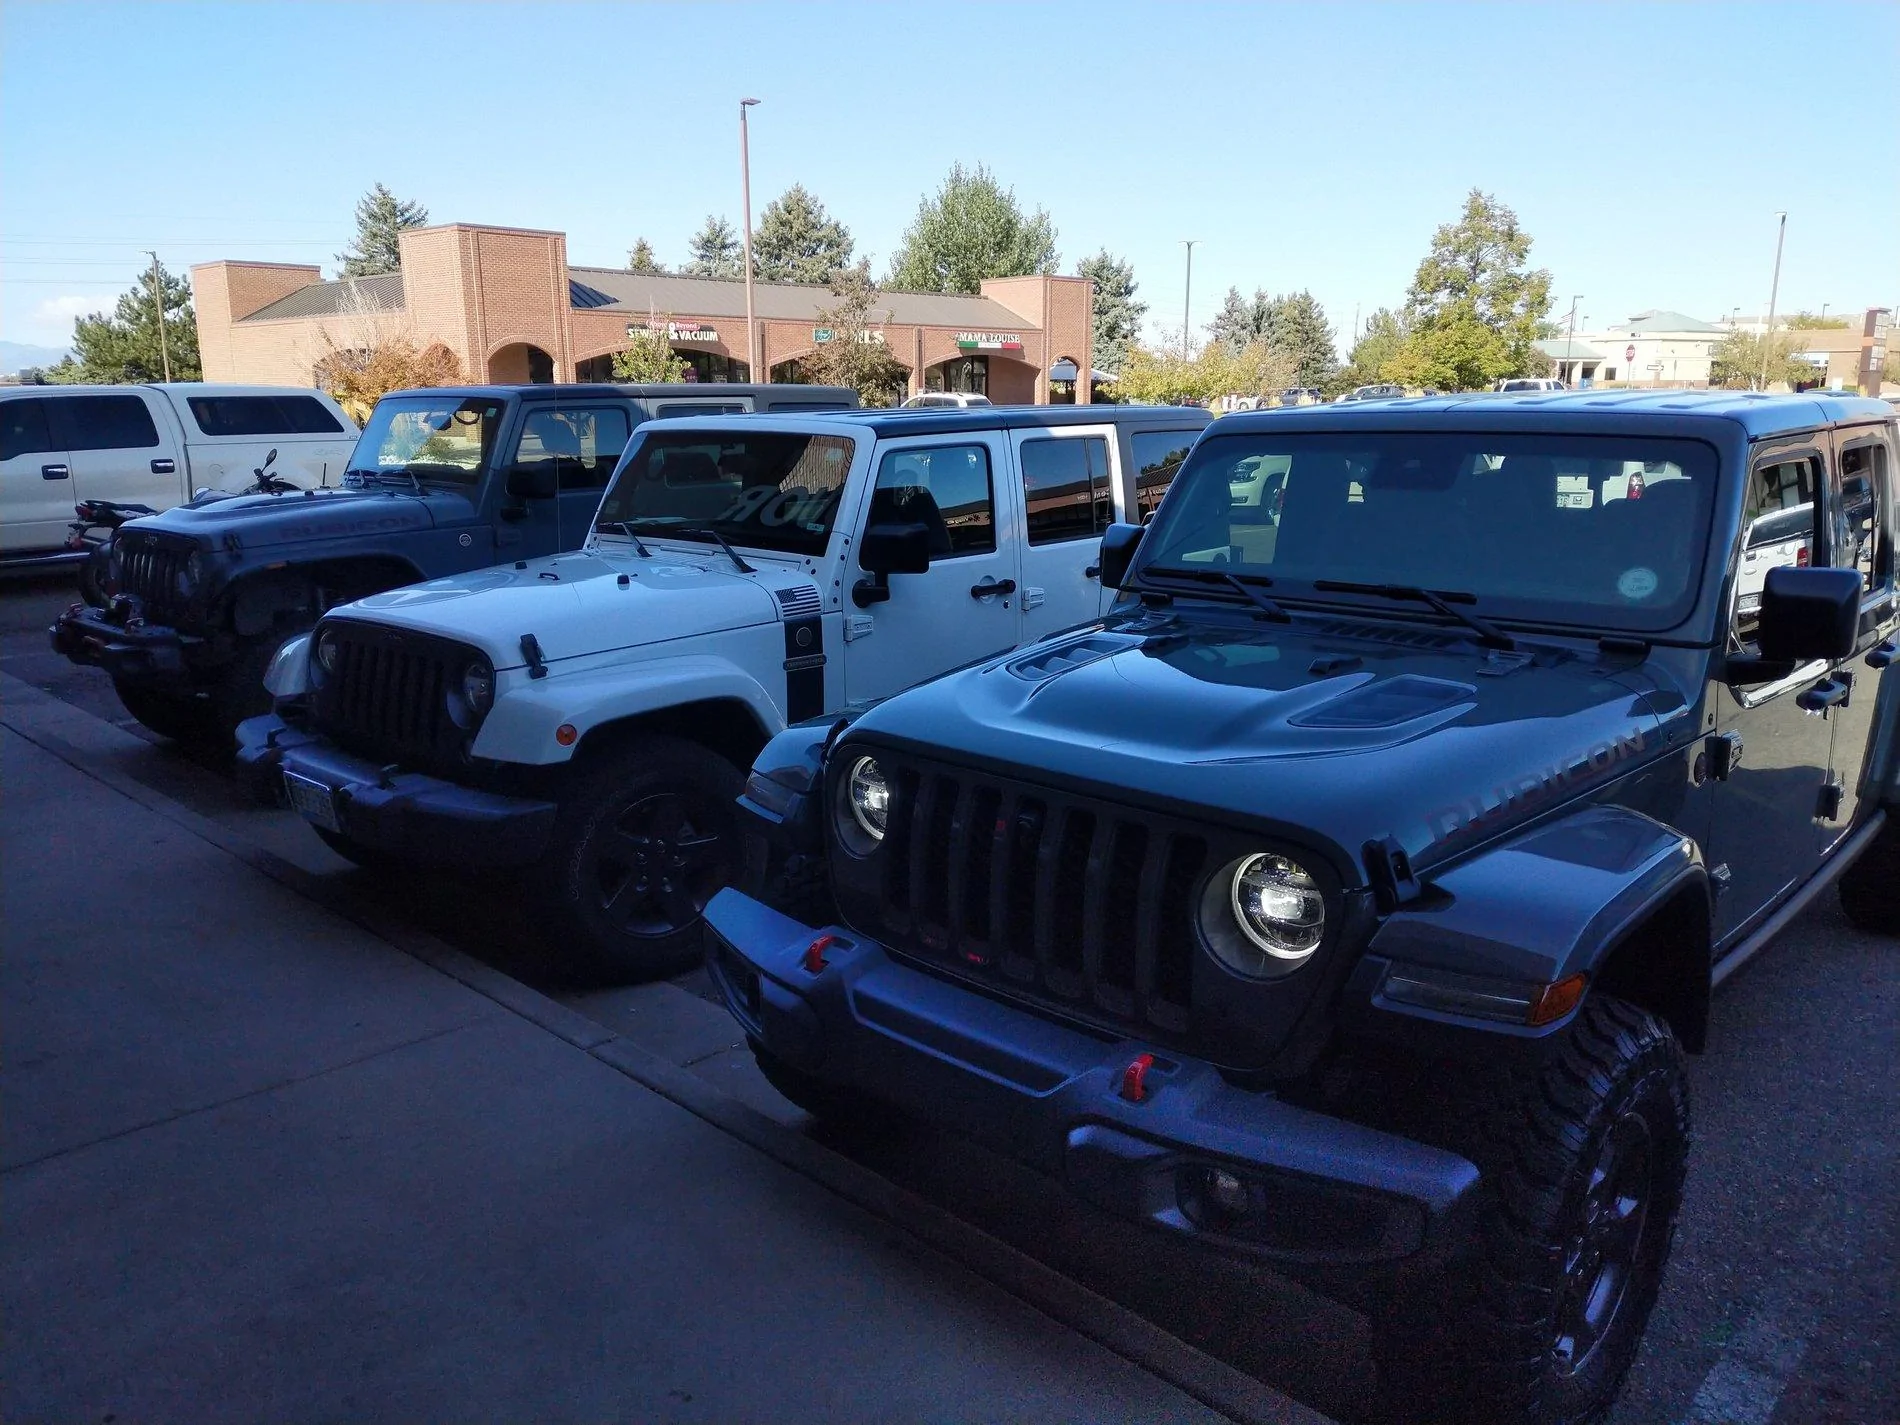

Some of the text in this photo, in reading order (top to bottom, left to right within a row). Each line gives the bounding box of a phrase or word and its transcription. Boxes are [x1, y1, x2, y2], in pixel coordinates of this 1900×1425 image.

[676, 322, 698, 330] Beyond
[679, 330, 718, 341] VACUUM
[959, 332, 1020, 343] MAMA LOUISE
